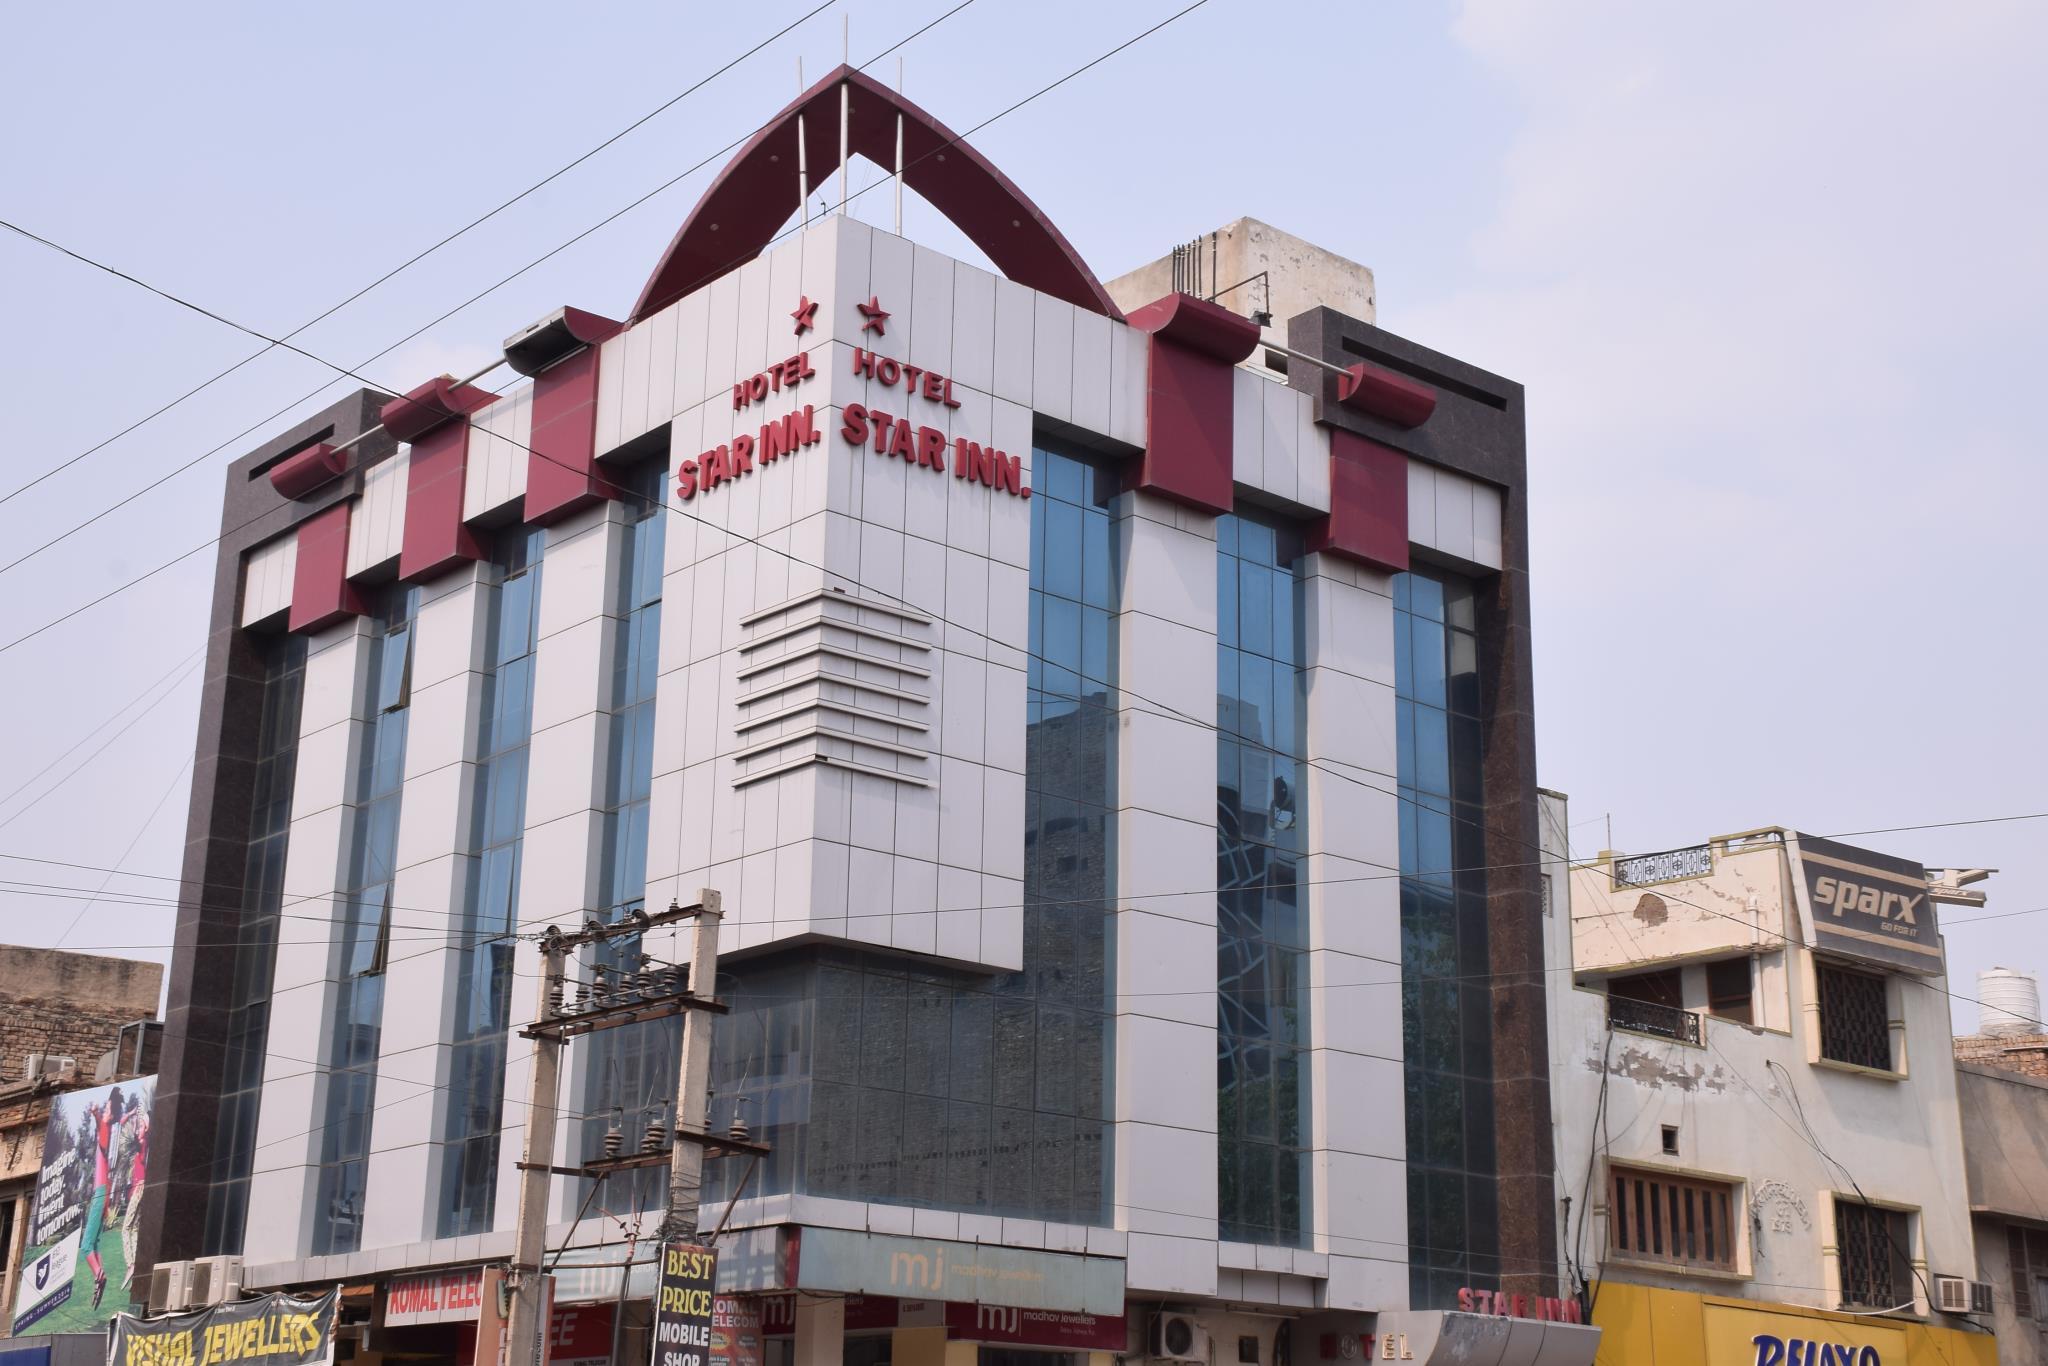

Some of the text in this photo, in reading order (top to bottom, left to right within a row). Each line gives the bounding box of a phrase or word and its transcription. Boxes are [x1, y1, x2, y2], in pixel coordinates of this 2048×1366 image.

[733, 352, 816, 411] HOTEL
[854, 347, 961, 409] HOTEL
[677, 434, 754, 500] STAR
[841, 403, 1032, 498] STAR INN.
[1813, 876, 1924, 925] sparx
[42, 1148, 76, 1184] Imagine
[667, 1250, 713, 1280] BEST
[890, 1248, 944, 1291] mj
[389, 1280, 438, 1315] KOMAL
[660, 1286, 712, 1317] PRICE
[1459, 1287, 1582, 1324] STAR INN
[659, 1322, 710, 1346] MOBILE
[977, 1303, 1018, 1333] mj
[1024, 1311, 1060, 1322] madhav
[126, 1312, 322, 1366] VISHAL JEWELLERS
